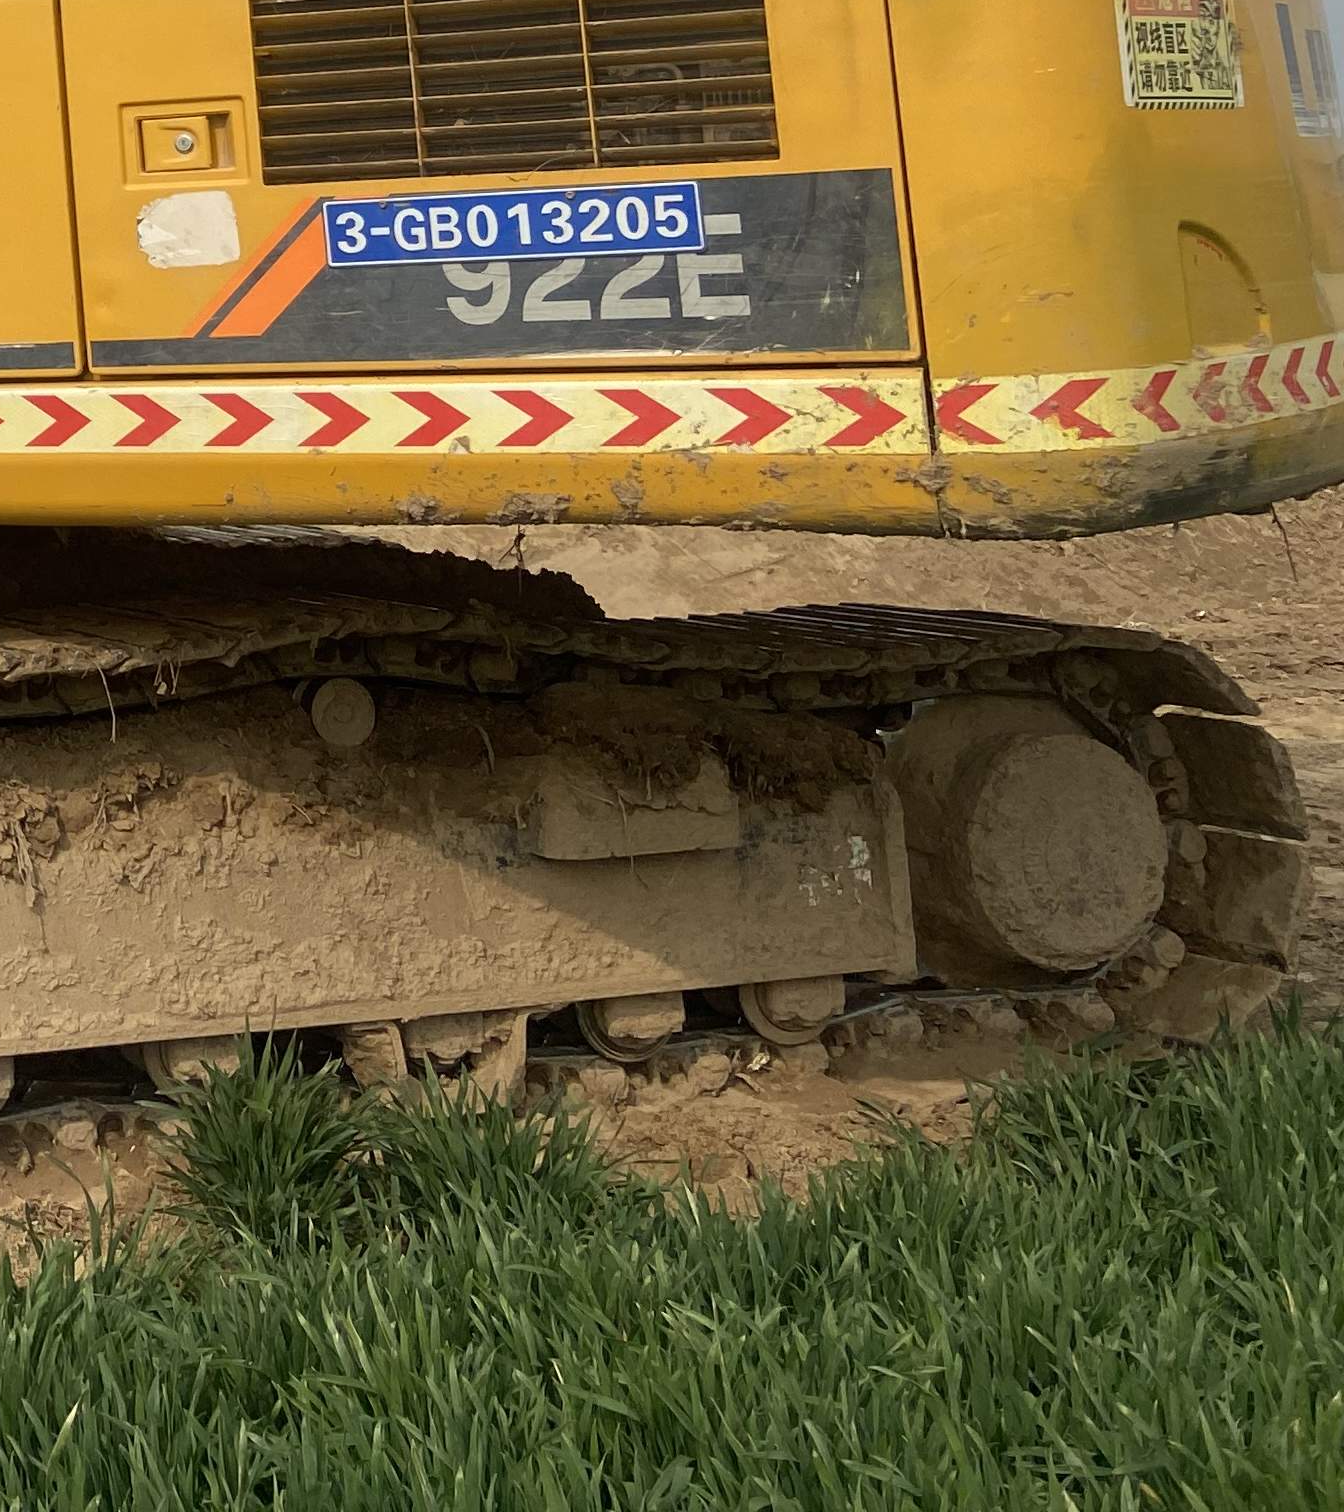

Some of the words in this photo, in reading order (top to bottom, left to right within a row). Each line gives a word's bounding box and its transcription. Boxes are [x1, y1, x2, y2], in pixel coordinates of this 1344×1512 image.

[1136, 22, 1188, 54] 视线盲区
[1139, 60, 1193, 92] 请勿靠近
[335, 194, 689, 254] 3-GB013205
